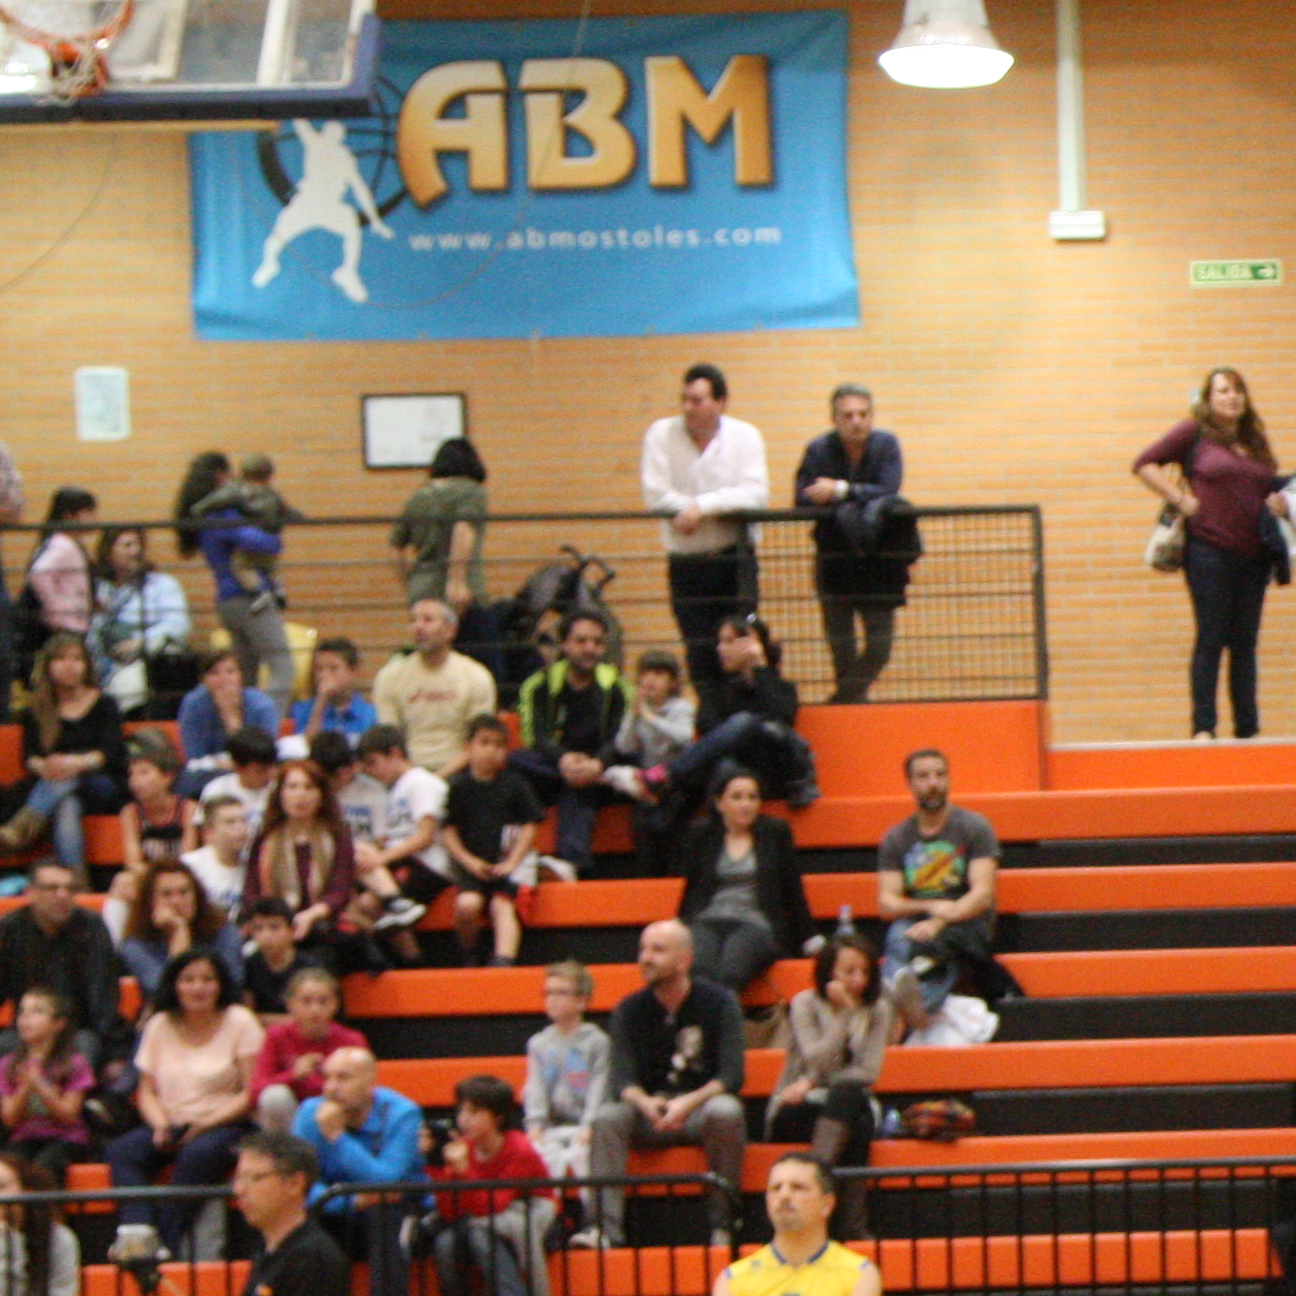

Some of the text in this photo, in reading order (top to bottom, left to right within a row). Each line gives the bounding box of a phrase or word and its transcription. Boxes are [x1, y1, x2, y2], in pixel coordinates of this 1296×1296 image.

[396, 53, 775, 211] ABM
[408, 223, 783, 251] www.abmostoles.com
[1196, 263, 1250, 280] SALIDA
